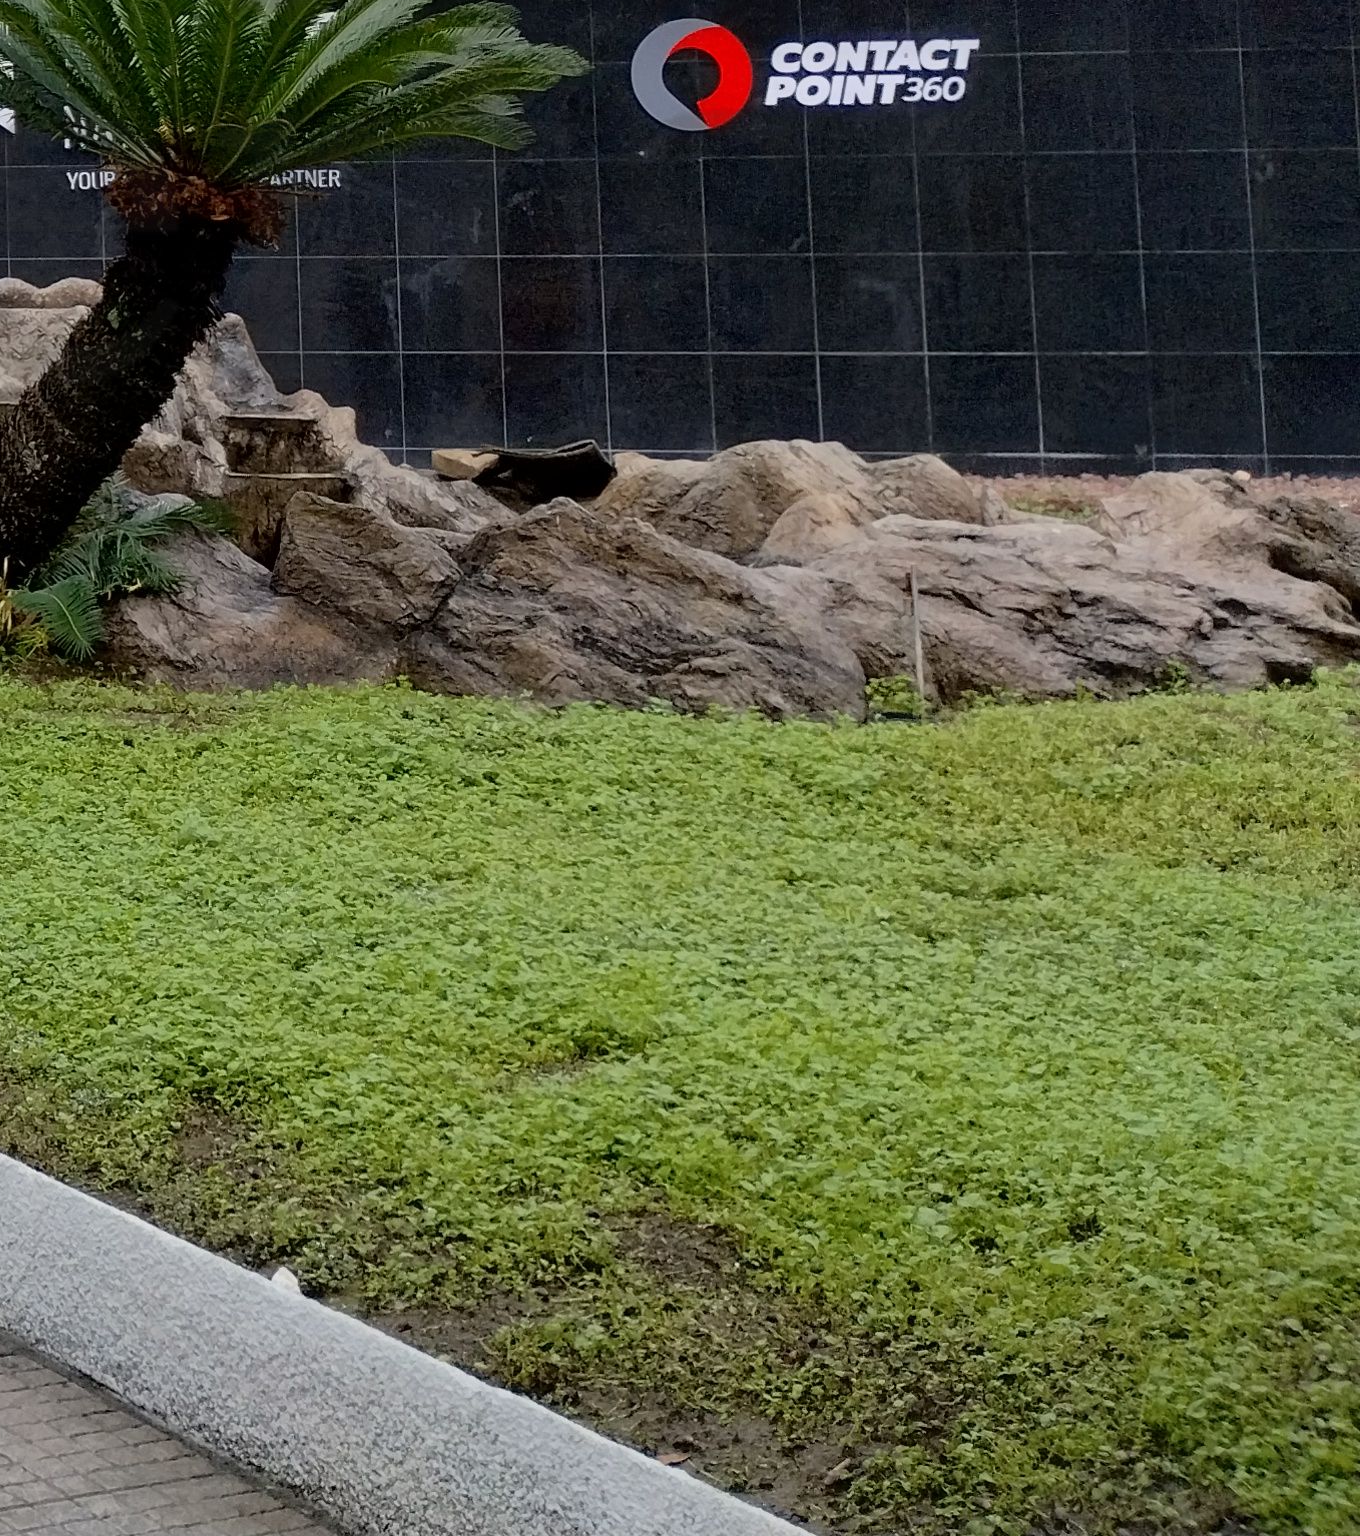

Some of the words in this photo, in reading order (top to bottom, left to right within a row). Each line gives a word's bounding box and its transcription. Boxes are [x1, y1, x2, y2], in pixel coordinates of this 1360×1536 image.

[770, 38, 980, 73] CONTACT
[764, 74, 966, 107] POINT360
[66, 171, 116, 191] YOUR
[260, 168, 342, 189] ARTNER
